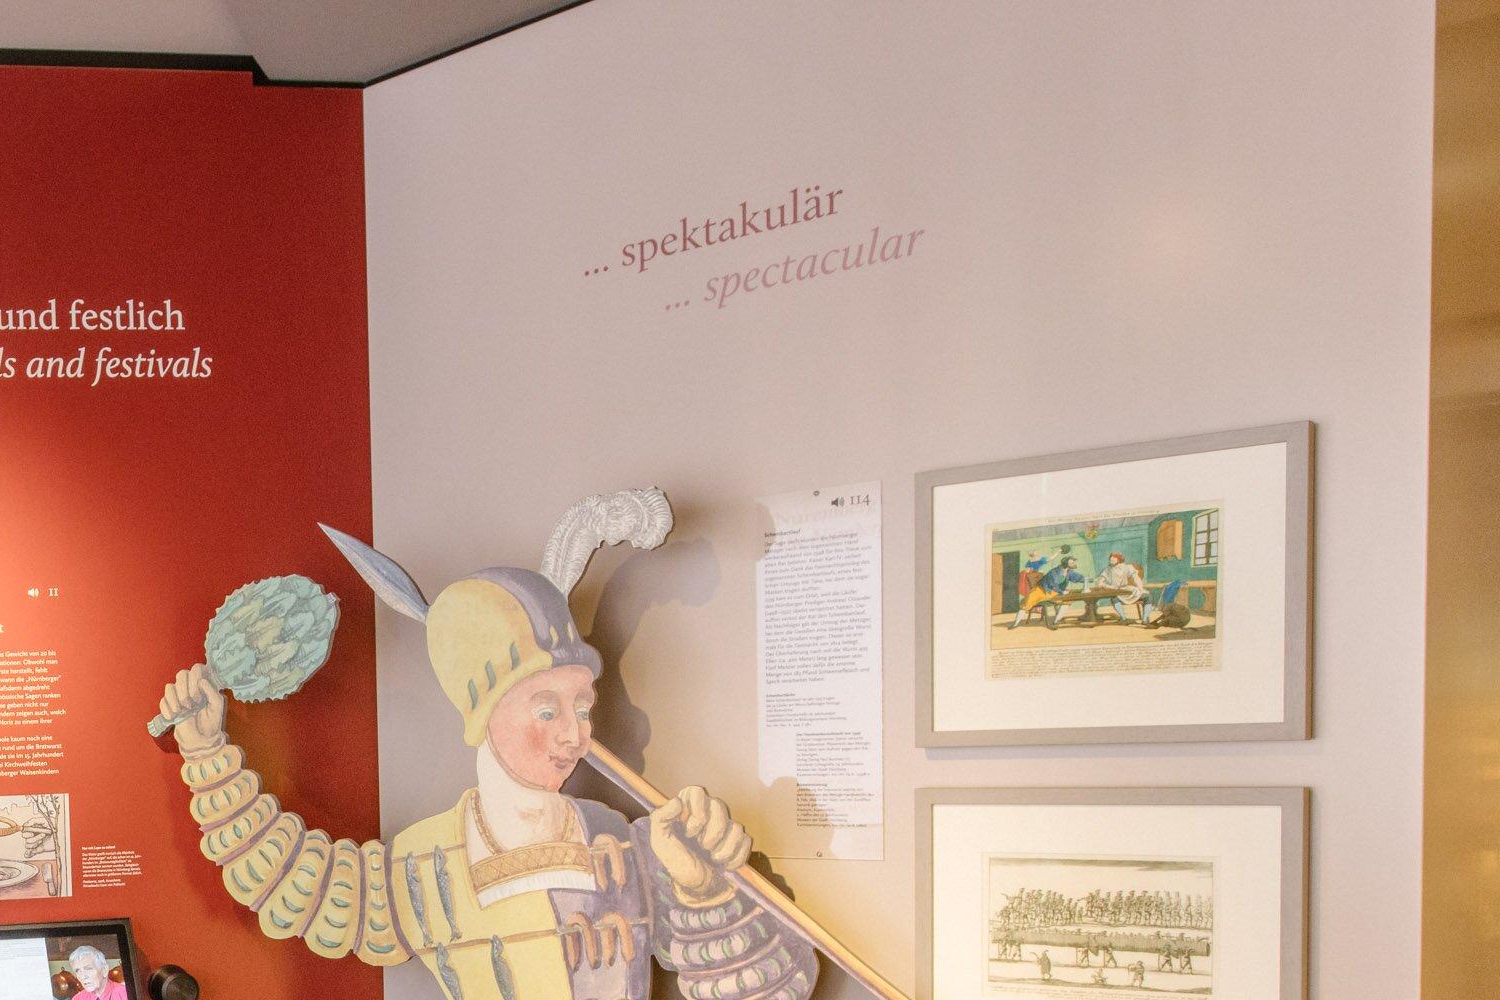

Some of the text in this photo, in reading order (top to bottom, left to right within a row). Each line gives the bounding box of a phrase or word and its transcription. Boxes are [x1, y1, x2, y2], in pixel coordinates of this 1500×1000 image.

[621, 185, 844, 273] spektakulär
[704, 226, 926, 309] spectacular
[68, 298, 186, 331] festlich
[26, 347, 85, 380] and
[91, 346, 213, 387] festivals
[849, 493, 870, 507] 114
